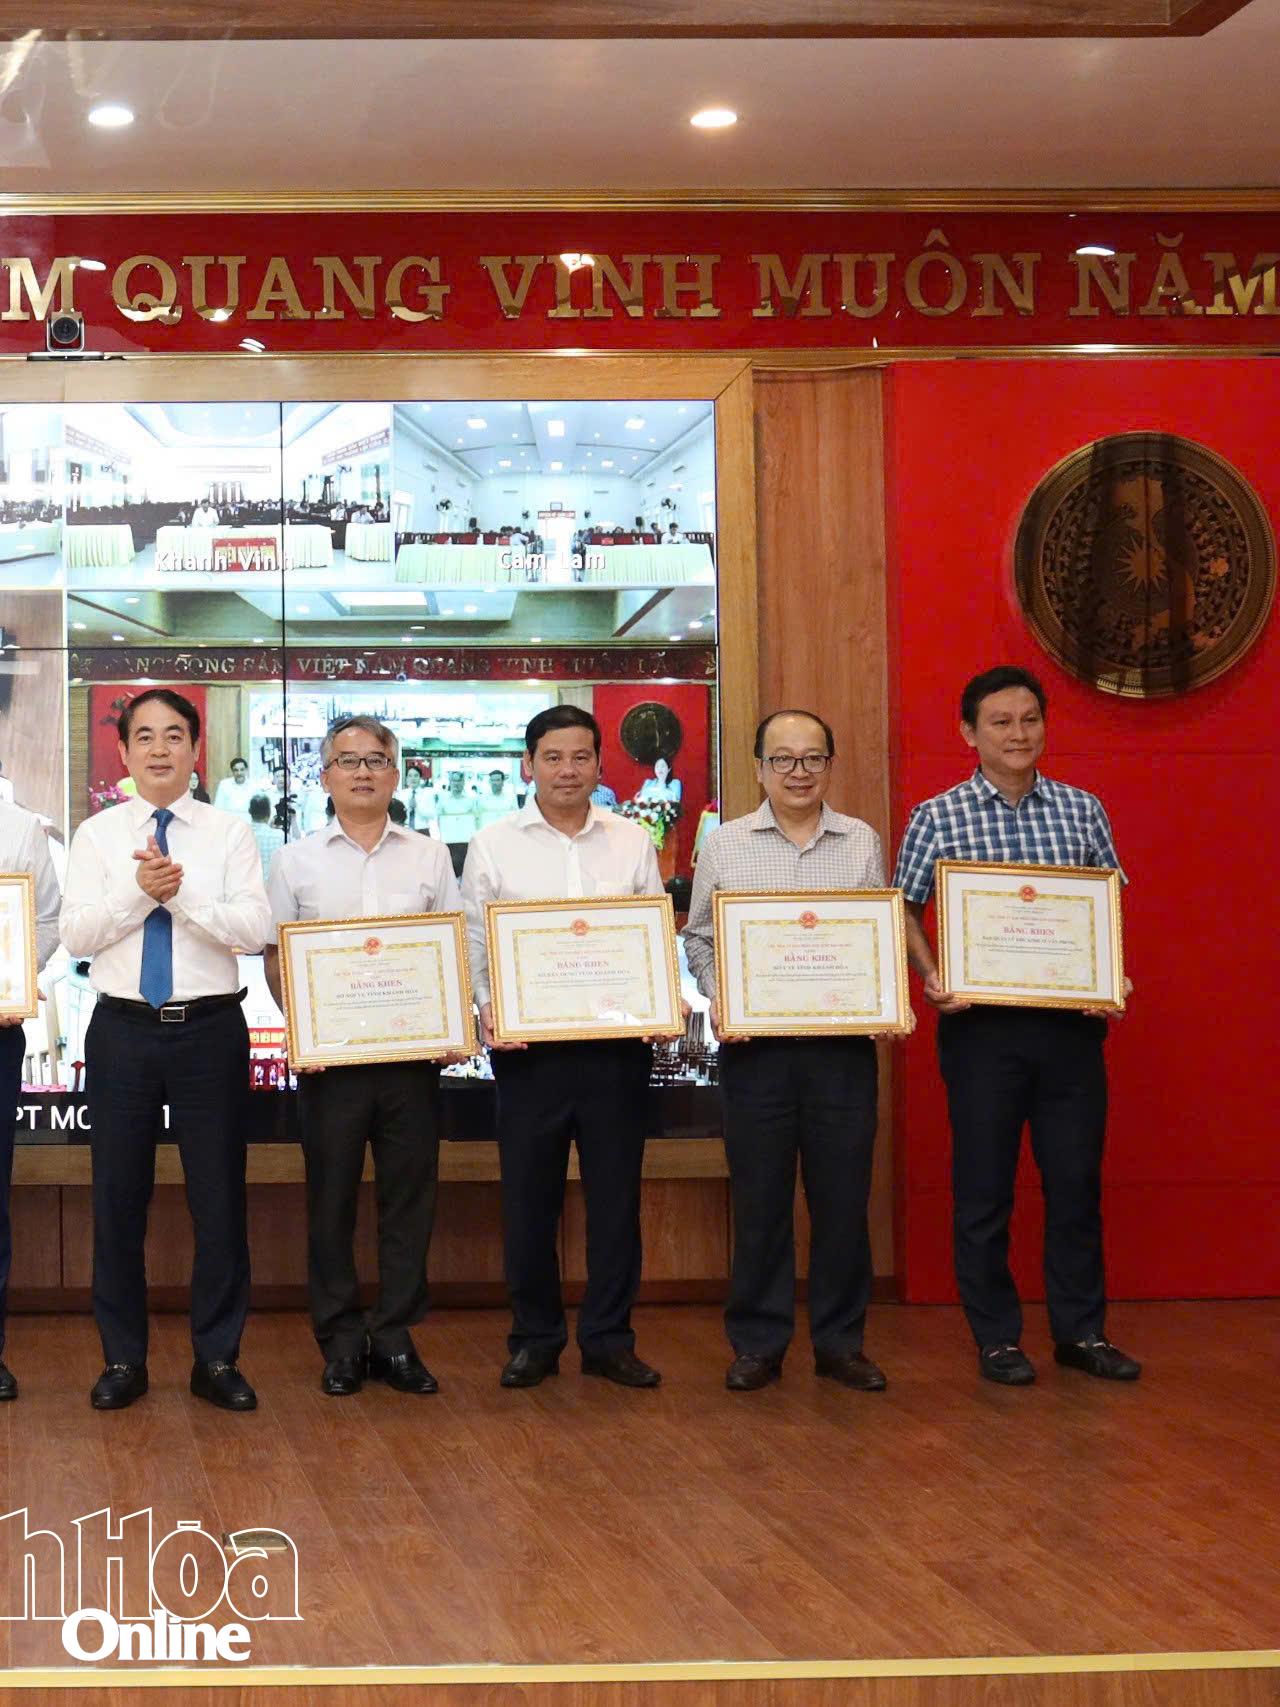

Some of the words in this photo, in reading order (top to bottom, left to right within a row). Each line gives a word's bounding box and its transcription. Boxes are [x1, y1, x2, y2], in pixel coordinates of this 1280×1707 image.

[111, 255, 451, 325] QUANG
[480, 253, 721, 318] VINH
[752, 228, 1040, 320] MUÔN
[1069, 231, 1280, 318] NĂM
[501, 551, 546, 570] Cam
